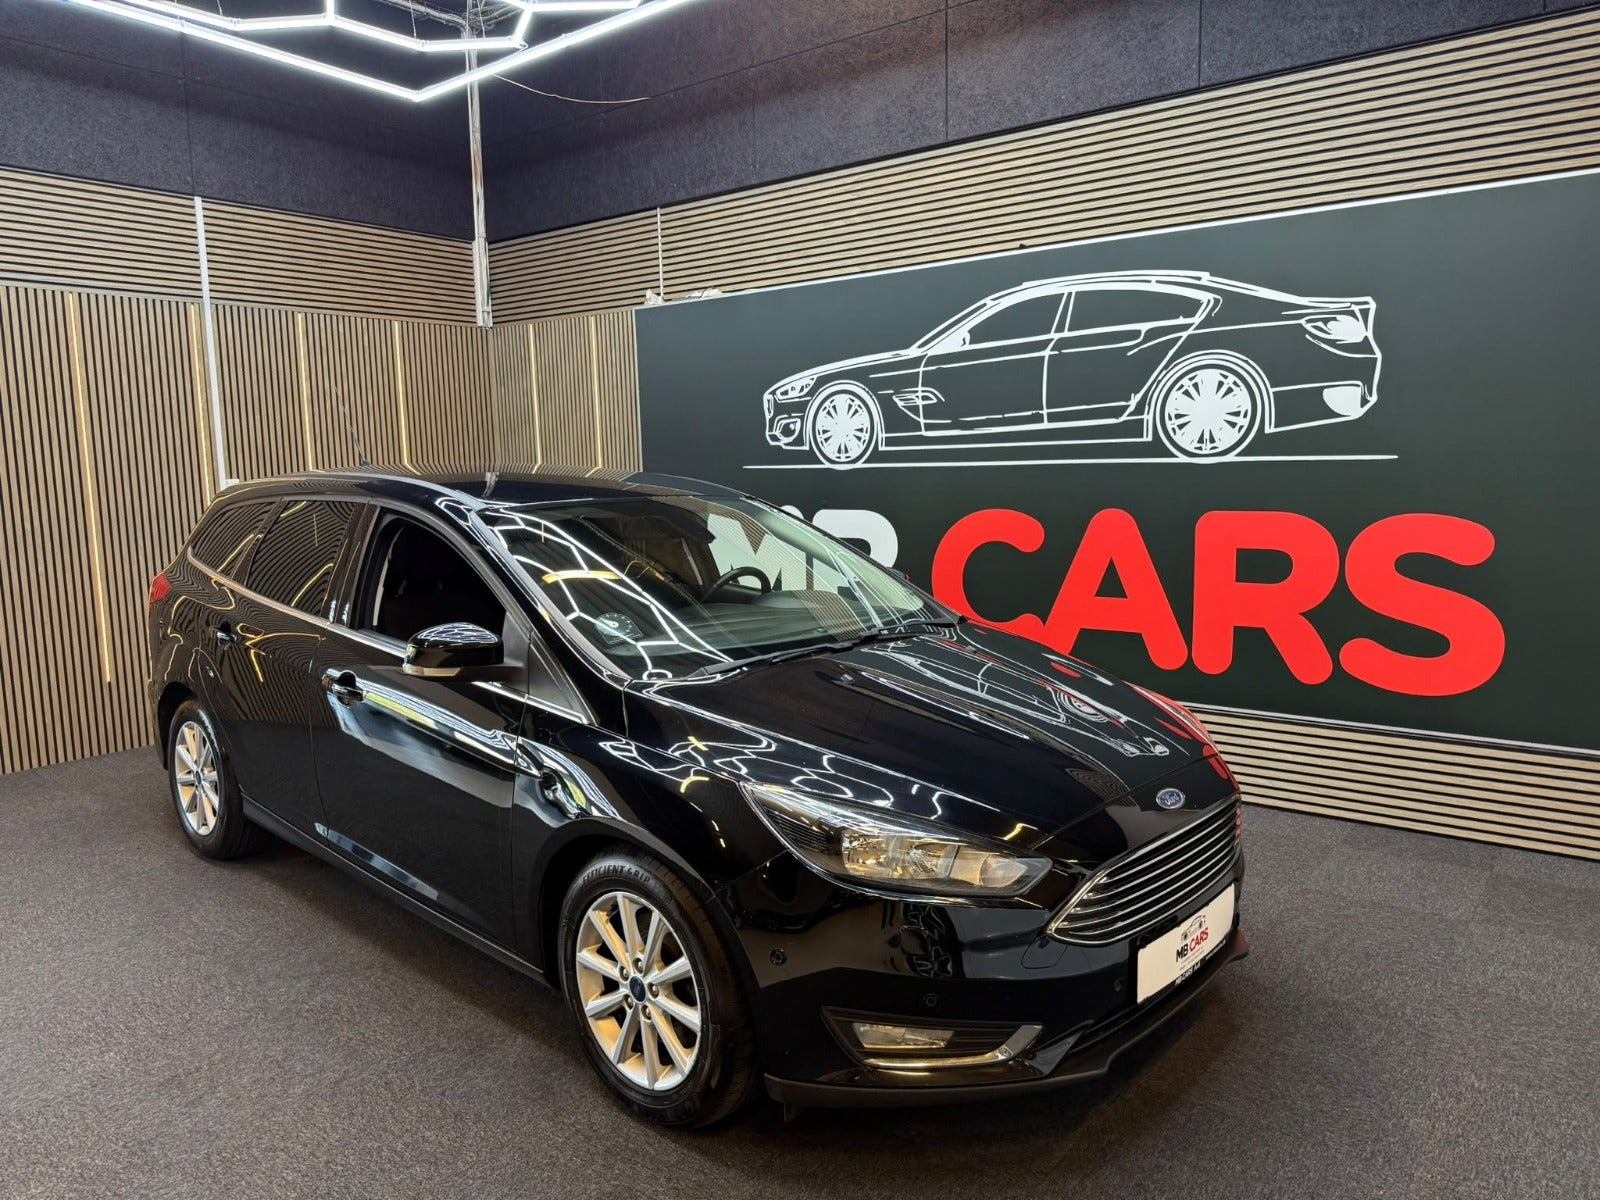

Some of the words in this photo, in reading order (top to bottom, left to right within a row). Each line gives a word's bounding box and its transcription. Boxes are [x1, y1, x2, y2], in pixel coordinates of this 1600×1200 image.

[931, 508, 1506, 696] CARS
[582, 864, 626, 884] EFFICIENT
[627, 867, 652, 883] GRIP
[1176, 943, 1188, 962] MB
[1189, 927, 1208, 952] CARS
